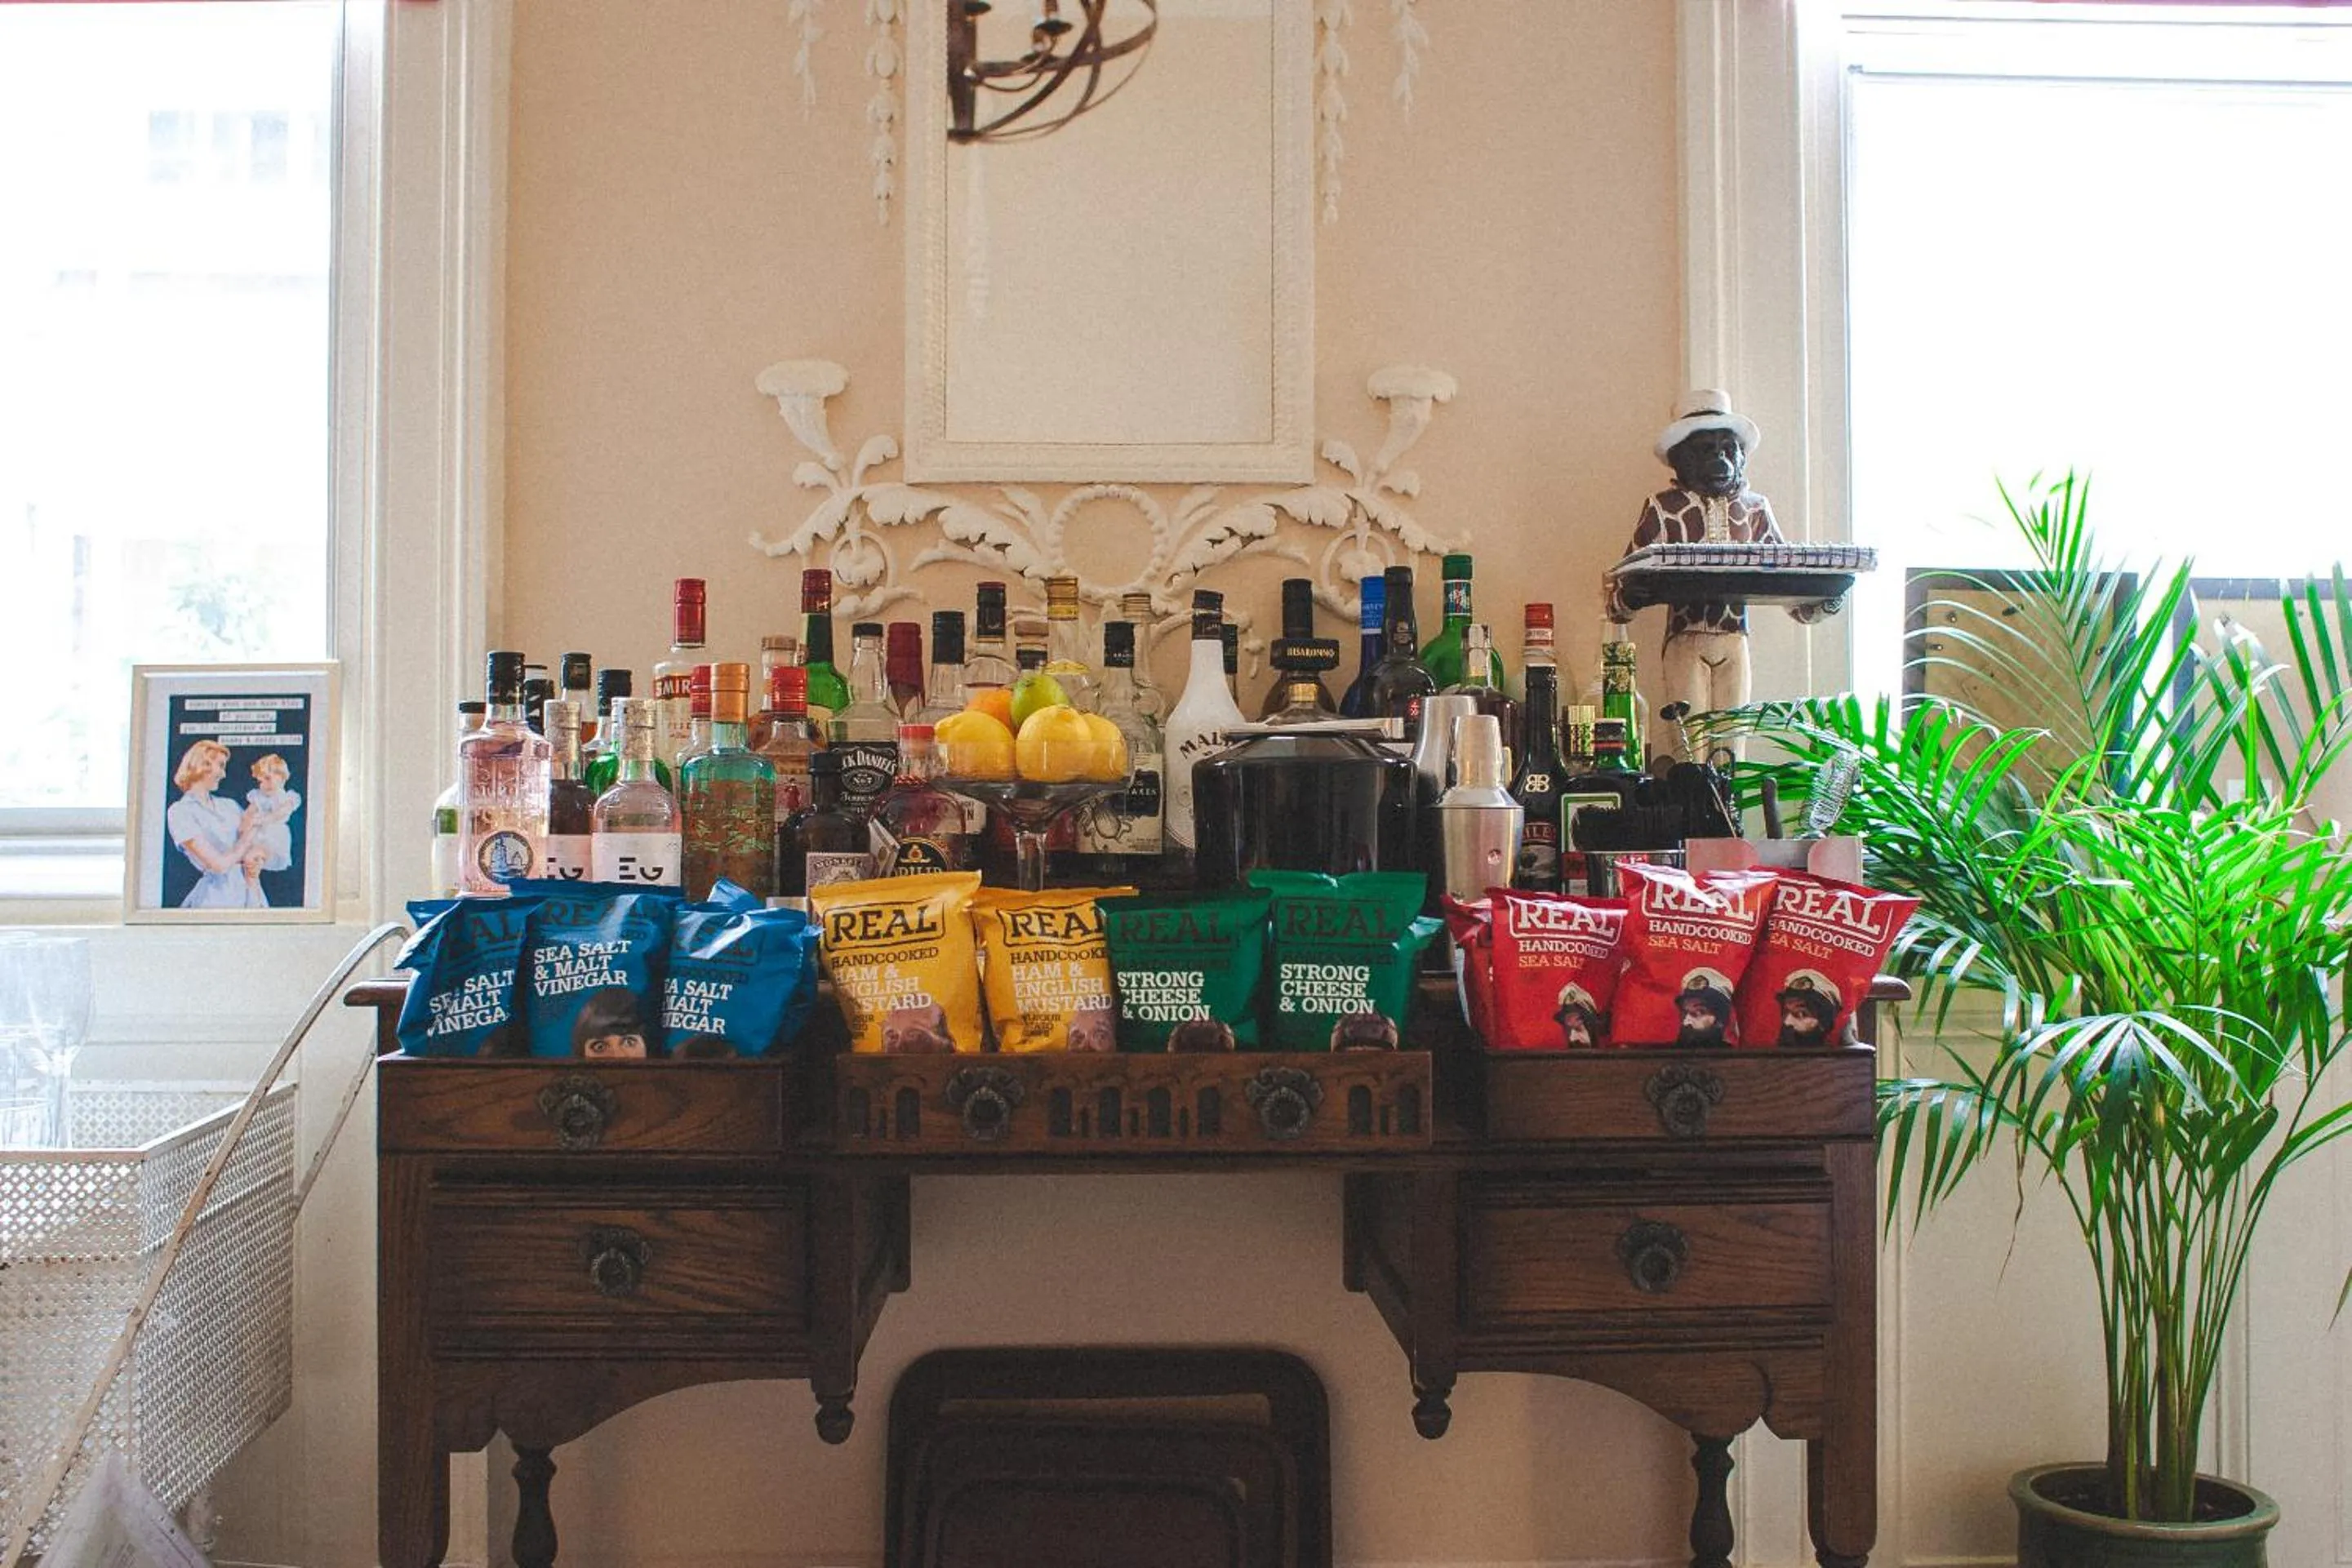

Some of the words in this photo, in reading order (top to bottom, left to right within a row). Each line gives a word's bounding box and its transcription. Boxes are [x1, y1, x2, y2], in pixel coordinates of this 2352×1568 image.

[656, 678, 691, 697] SMIR
[1179, 731, 1223, 759] MAL
[1651, 881, 1754, 922] REAL
[1773, 885, 1881, 935] REAL
[831, 904, 937, 943] REAL
[1119, 909, 1231, 945] REAL
[1285, 903, 1399, 940] REAL
[1517, 899, 1616, 938] REAL
[1649, 919, 1752, 944] HANDCOOKED
[1768, 919, 1875, 957] HANDCOOKED
[533, 944, 574, 965] SEA
[578, 939, 632, 957] SALT
[1648, 935, 1678, 948] SEA
[1682, 938, 1722, 955] SALT
[1792, 939, 1833, 960] SALT
[534, 965, 549, 980] &
[554, 954, 612, 978] MALT
[831, 946, 939, 969] HANDCOOKED
[1010, 947, 1107, 966] HANDCOOKE
[1518, 954, 1550, 967] SEA
[464, 970, 515, 994] SALT
[1011, 962, 1063, 981] HAM
[1117, 971, 1205, 988] STRONG
[1280, 963, 1371, 981] STRONG
[534, 970, 629, 997] VINEGAR
[683, 979, 733, 1001] SALT
[844, 976, 919, 997] NGLISH
[1015, 976, 1104, 997] ENGLISH
[1280, 981, 1367, 999] CHEESE
[856, 993, 932, 1014] STARD
[1016, 993, 1113, 1014] MUSTARD
[1121, 988, 1202, 1005] CHEESE
[1279, 997, 1296, 1013] &
[1301, 997, 1376, 1015] ONION
[426, 1006, 510, 1037] VINEGA
[662, 1011, 727, 1035] EGAR
[1123, 1006, 1134, 1020] &
[1138, 1005, 1211, 1022] ONION
